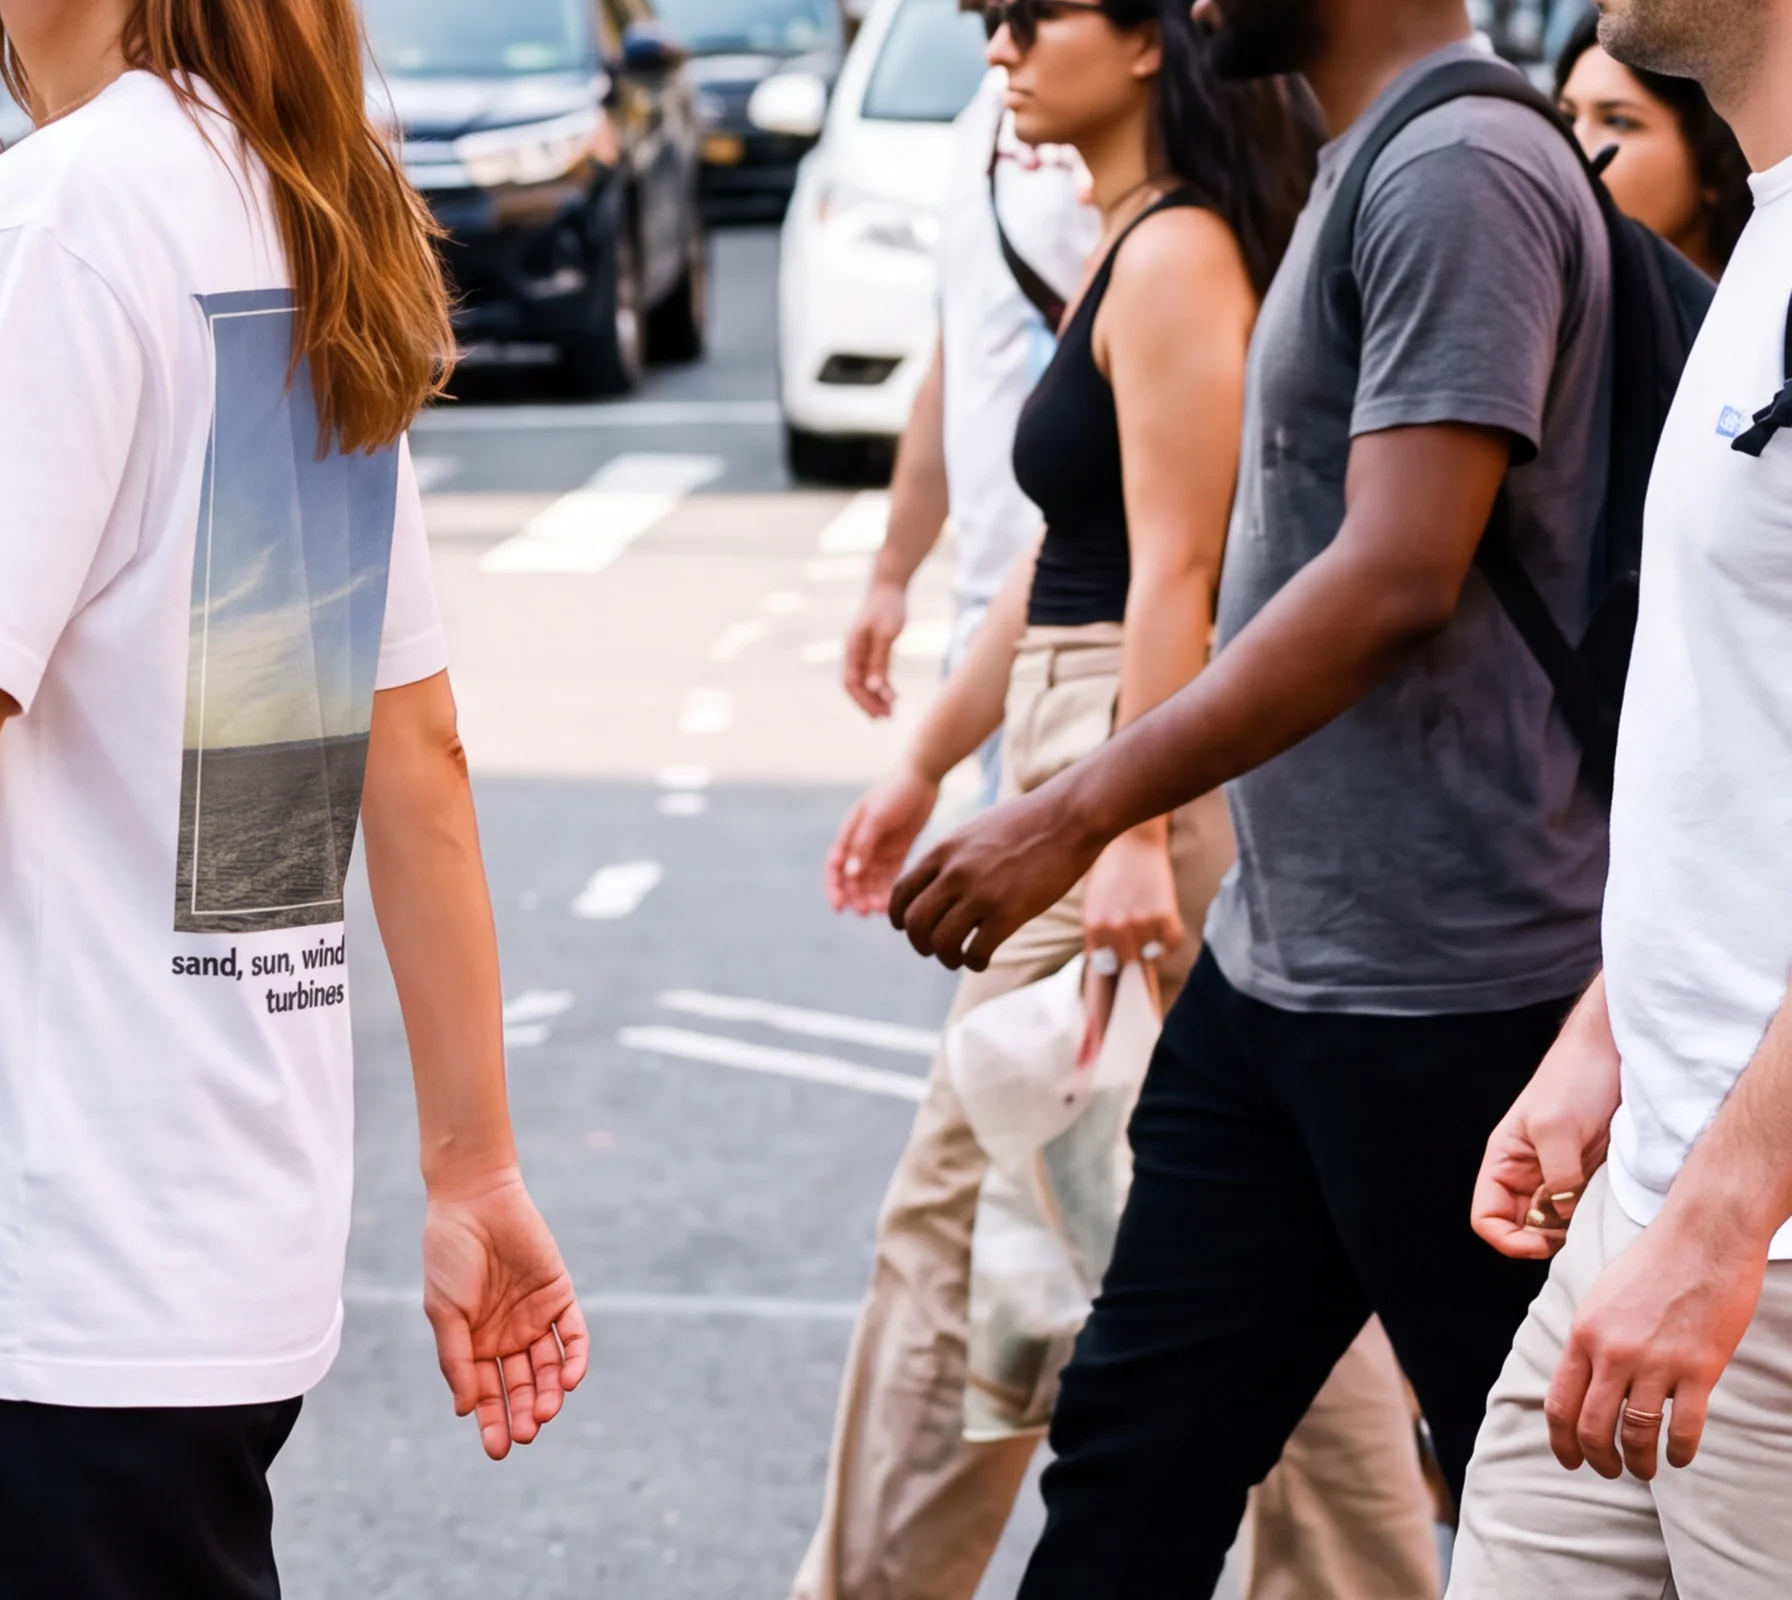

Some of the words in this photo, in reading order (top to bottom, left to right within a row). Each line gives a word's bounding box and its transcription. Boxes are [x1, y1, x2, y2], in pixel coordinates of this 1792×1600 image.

[172, 947, 243, 981] sand,
[251, 952, 294, 976] sun,
[302, 935, 345, 970] wind
[266, 980, 344, 1014] turbines
